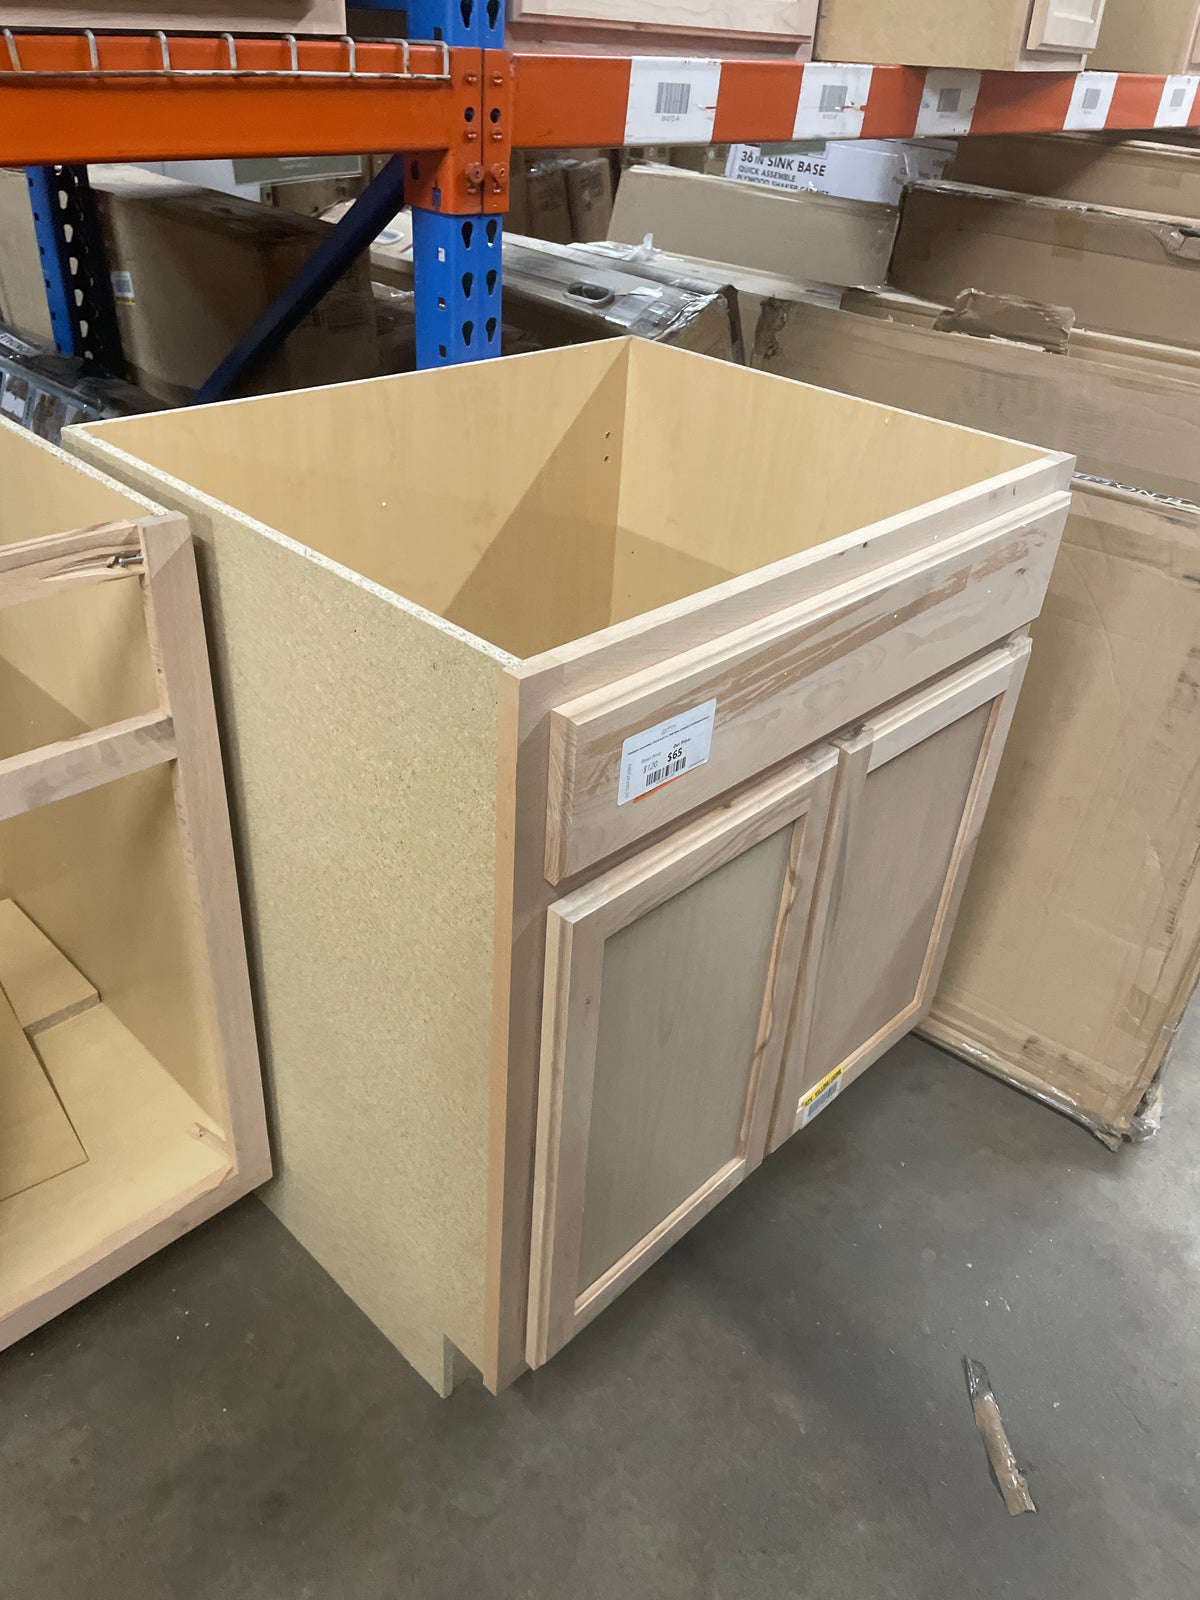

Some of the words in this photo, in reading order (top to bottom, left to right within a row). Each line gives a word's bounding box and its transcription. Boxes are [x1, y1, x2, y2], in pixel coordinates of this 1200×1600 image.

[741, 151, 754, 163] 36
[767, 157, 794, 171] SINK
[797, 161, 826, 176] BASE
[738, 165, 759, 175] QUICK
[761, 170, 797, 183] ASSEMBLE
[667, 747, 683, 763] $65
[643, 760, 659, 774] $120
